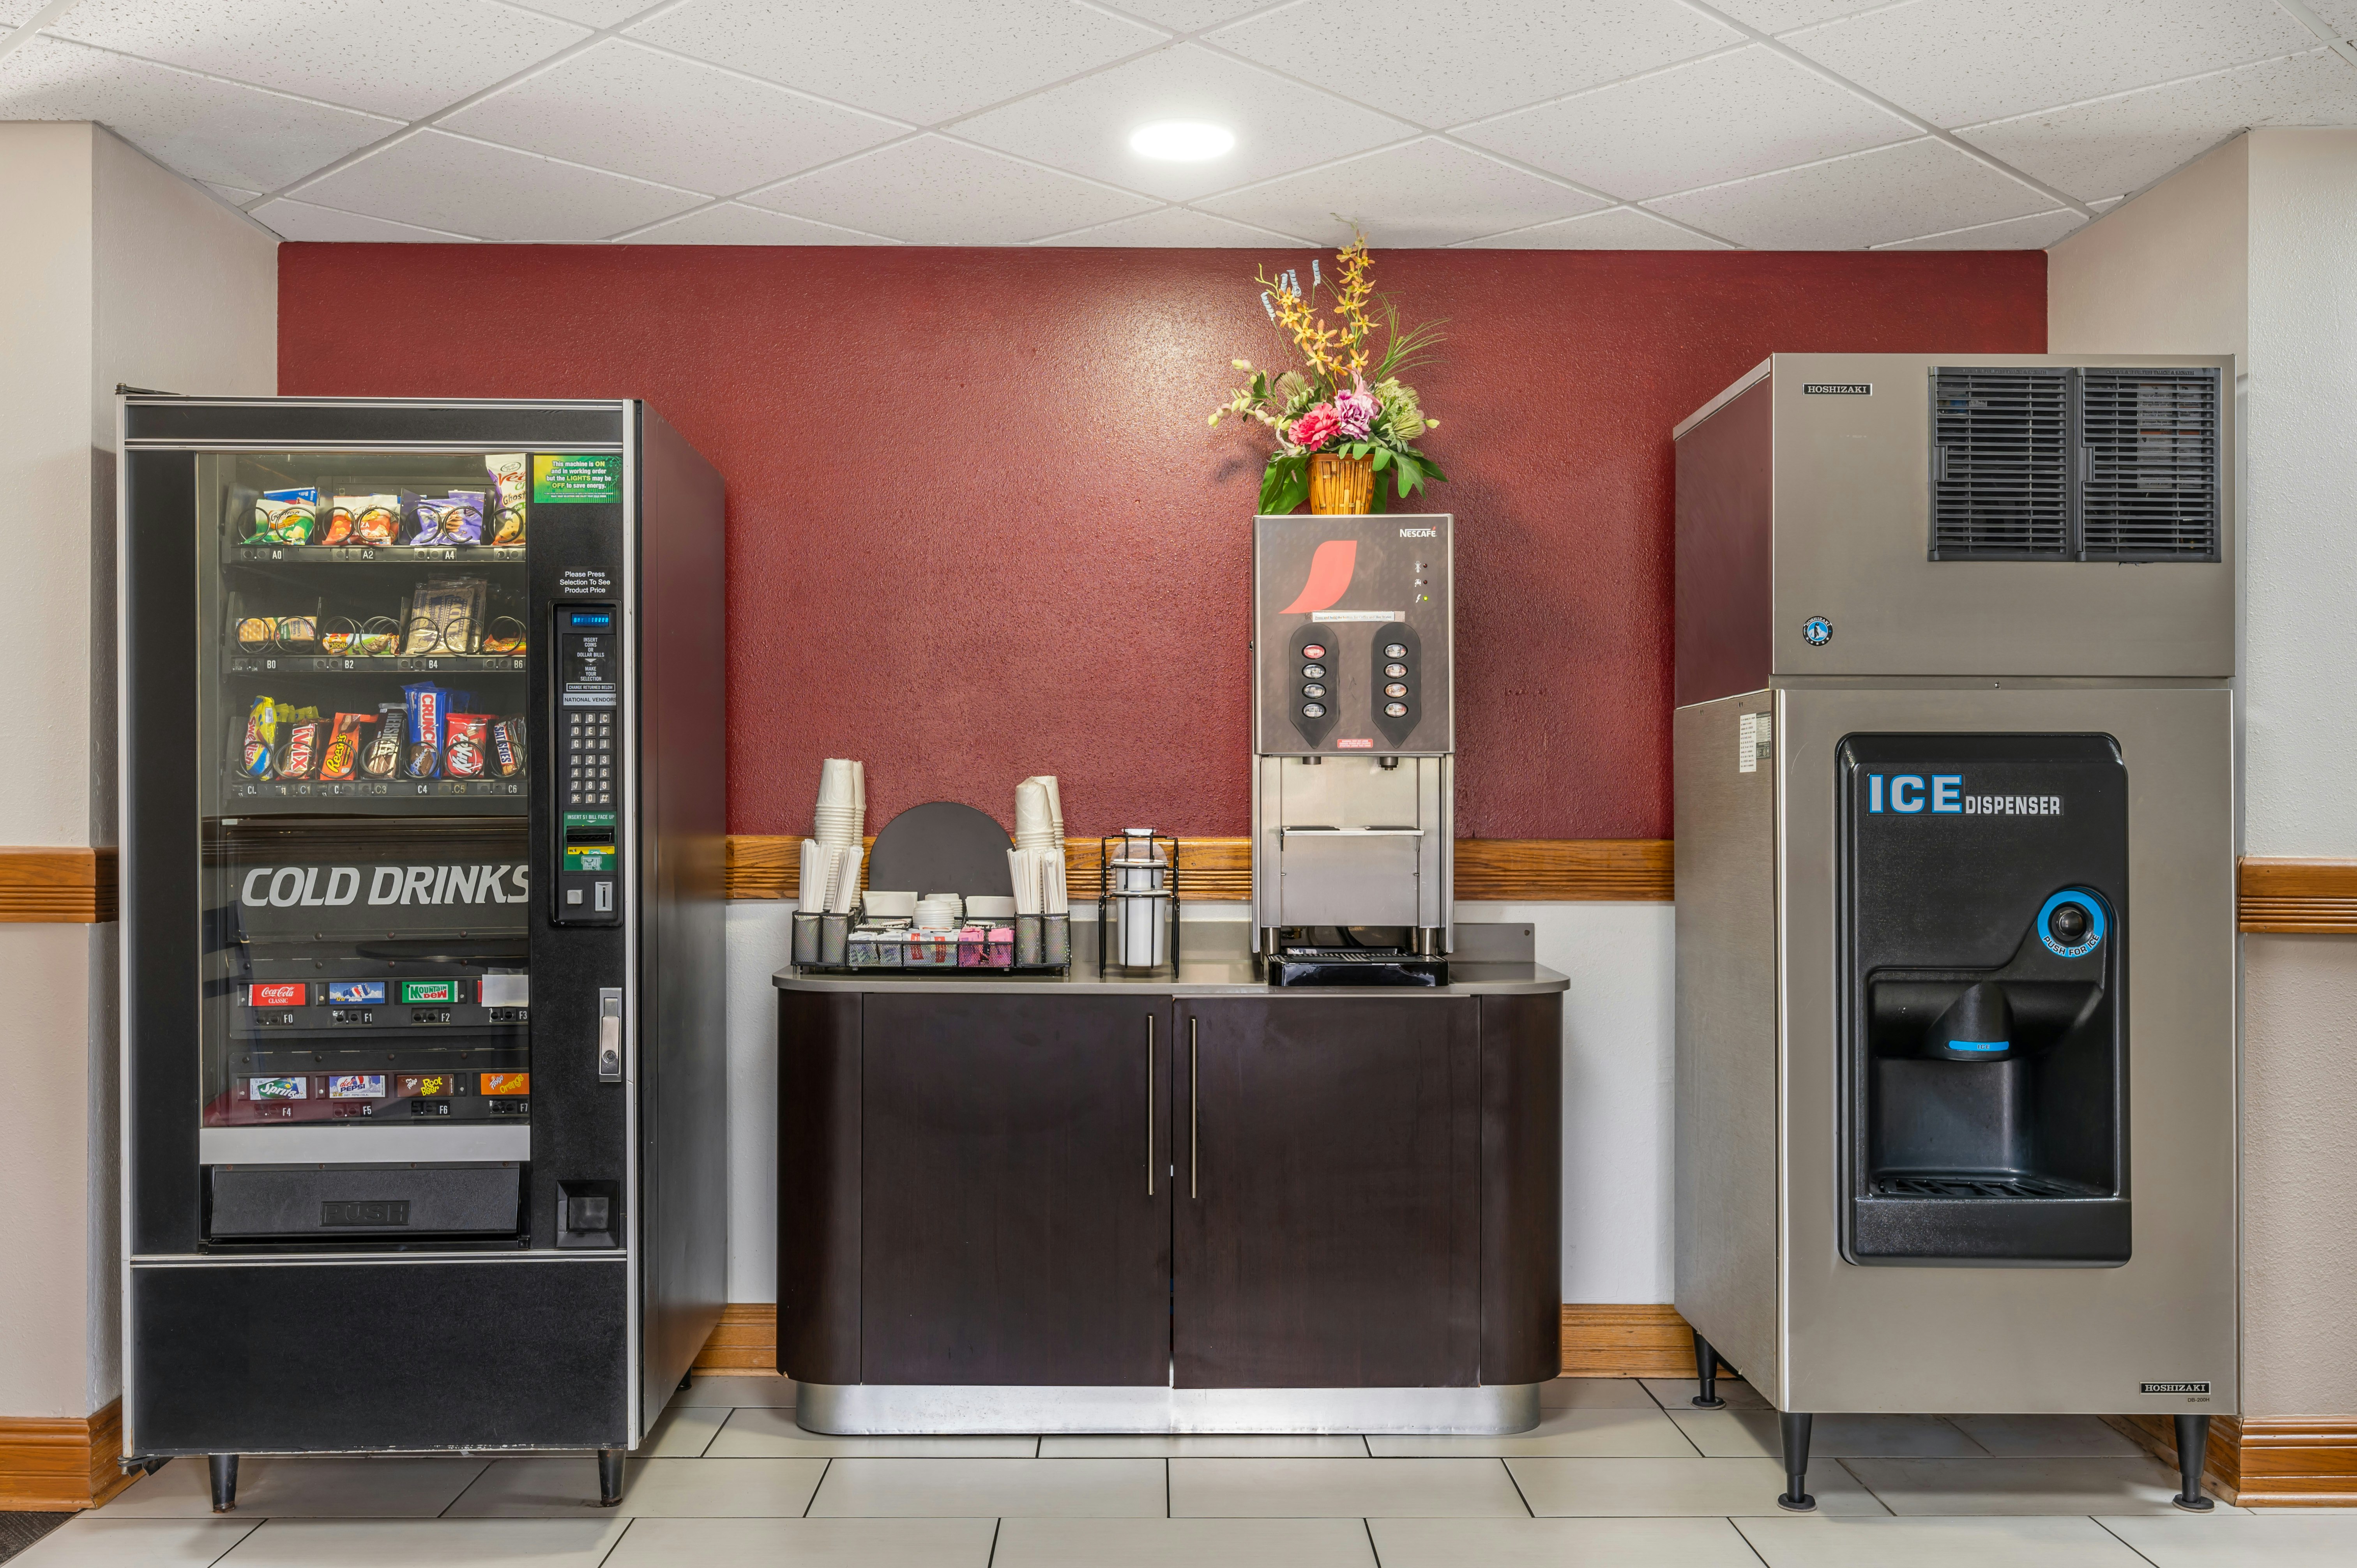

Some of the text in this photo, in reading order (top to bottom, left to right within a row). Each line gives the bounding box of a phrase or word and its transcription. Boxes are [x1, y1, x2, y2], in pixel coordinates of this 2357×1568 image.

[1399, 526, 1436, 537] NESCAFÉ
[272, 551, 282, 559] A0
[363, 550, 373, 559] A2
[445, 551, 454, 559] A4
[1805, 617, 1830, 627] HOSHIZAKI
[345, 660, 353, 668] B2
[429, 660, 438, 668] B4
[514, 660, 523, 668] B6
[300, 786, 310, 794] C1
[376, 785, 386, 794] C3
[418, 785, 427, 793] C4
[454, 785, 465, 793] C5
[508, 785, 517, 793] C6
[1869, 774, 2060, 814] ICE DISPENSER
[242, 865, 528, 906] COLD DRINKS
[2043, 934, 2100, 956] PUSH FOR ICE
[261, 986, 295, 998] Coca-Cola
[284, 1014, 293, 1023] F0
[365, 1013, 372, 1022] F1
[441, 1013, 450, 1022] F2
[519, 1011, 527, 1020] F3
[339, 1079, 355, 1088] diet
[406, 1078, 418, 1090] Faygo
[422, 1077, 443, 1088] Root
[489, 1075, 504, 1090] Faygo
[500, 1074, 524, 1094] Orange
[260, 1082, 297, 1097] Sprite
[341, 1083, 366, 1092] PEPSI
[283, 1108, 291, 1116] F4
[363, 1106, 371, 1115] F5
[440, 1105, 448, 1114] F6
[520, 1103, 528, 1112] F7
[324, 1204, 405, 1223] PUSH
